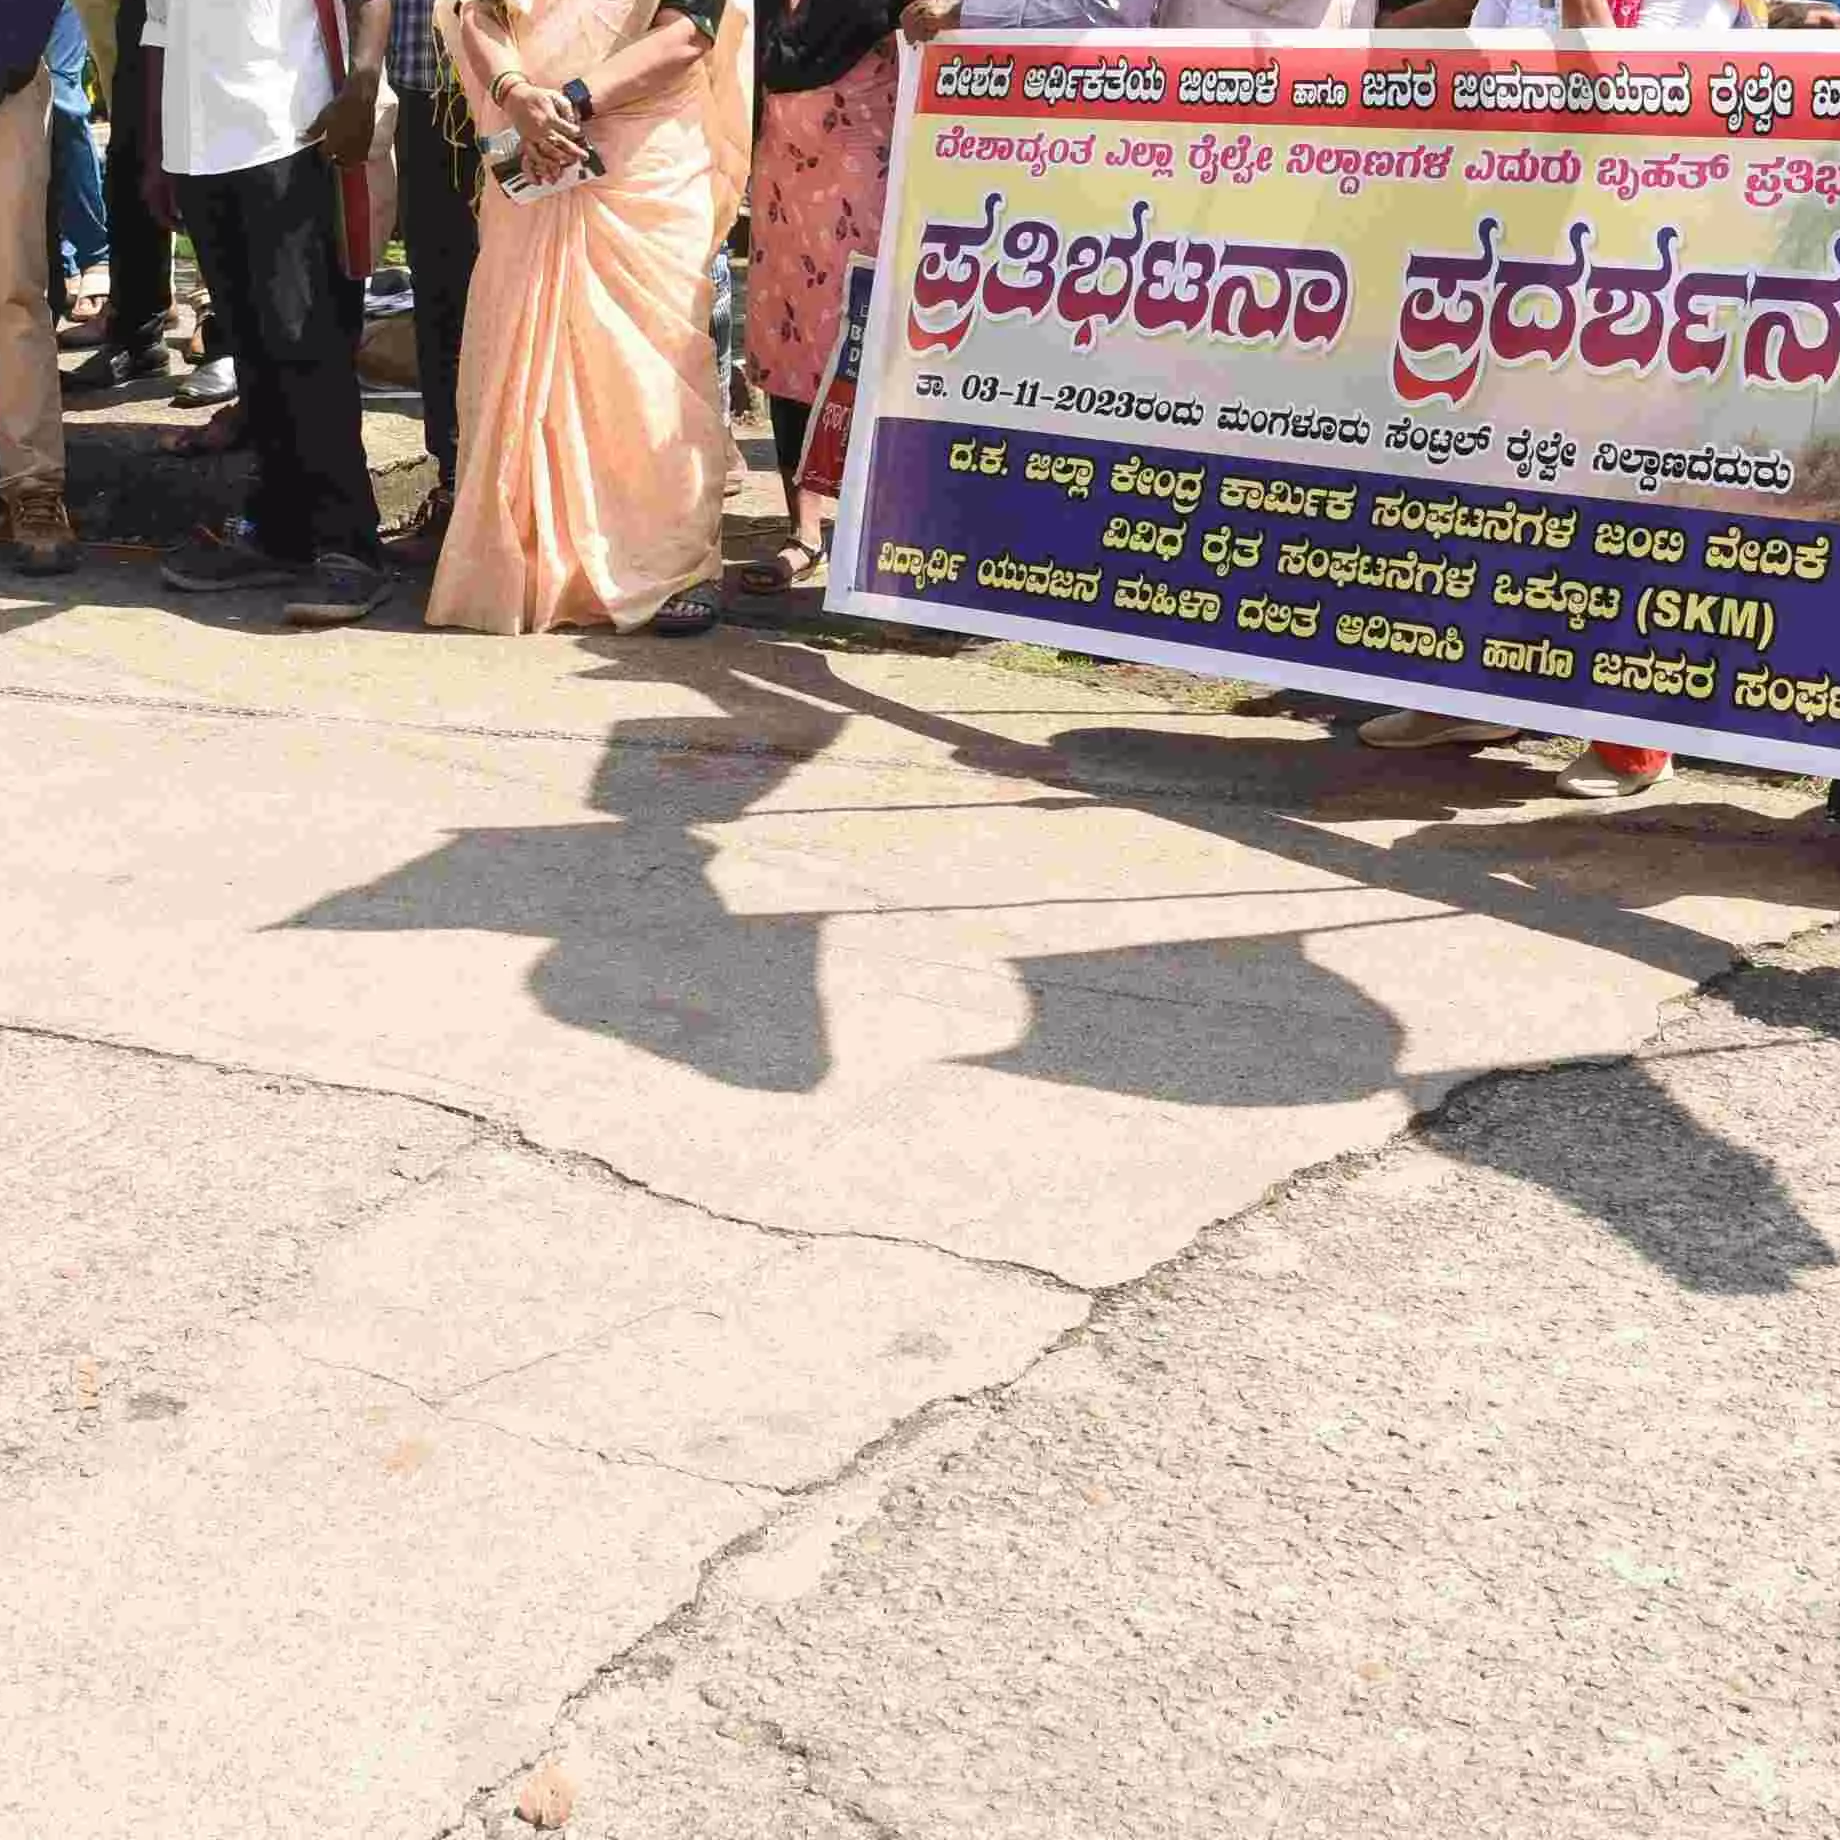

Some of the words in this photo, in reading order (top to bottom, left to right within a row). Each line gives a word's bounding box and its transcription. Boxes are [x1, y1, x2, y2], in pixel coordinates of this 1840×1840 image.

[935, 55, 1015, 100] ದೇಶದ
[1180, 60, 1279, 108] ಜೀವಾಳ
[1293, 75, 1348, 108] ಹಾಗೂ
[1362, 61, 1437, 110] ಜನರ
[935, 125, 1095, 177] ದೇಶಾದ್ಯಂತ
[1106, 138, 1174, 178] ಎಲ್ಲಾ
[1464, 146, 1583, 184] ಎದುರು
[1596, 151, 1729, 201] ಬೃಹತ್
[906, 191, 1352, 356] ಪ್ರತಿಭಟನಾ
[1216, 401, 1371, 446] ಮಂಗಳೂರು
[1110, 456, 1205, 514] ಕೇಂದ್ರ
[1218, 473, 1357, 520] ಕಾರ್ಮಿಕ
[1371, 491, 1577, 550] ಸಂಘಟನೆಗಳ
[1594, 522, 1685, 562] ಜಂಟಿ
[1704, 526, 1830, 581] ವೇದಿಕೆ
[976, 555, 1102, 604] ಯುವಜನ
[1113, 574, 1221, 623] ಮಹಿಳಾ
[1237, 596, 1321, 639] ದಲಿತ
[1335, 611, 1466, 663] ಆದಿವಾಸಿ
[1482, 635, 1575, 680] ಹಾಗೂ
[1592, 651, 1717, 700] ಜನಪರ
[1102, 515, 1187, 562] ವಿವಿಧ
[1201, 526, 1263, 579] ರೈತ
[1277, 537, 1478, 600] ಸಂಘಟನೆಗಳ
[1636, 586, 1777, 651] (SKM)
